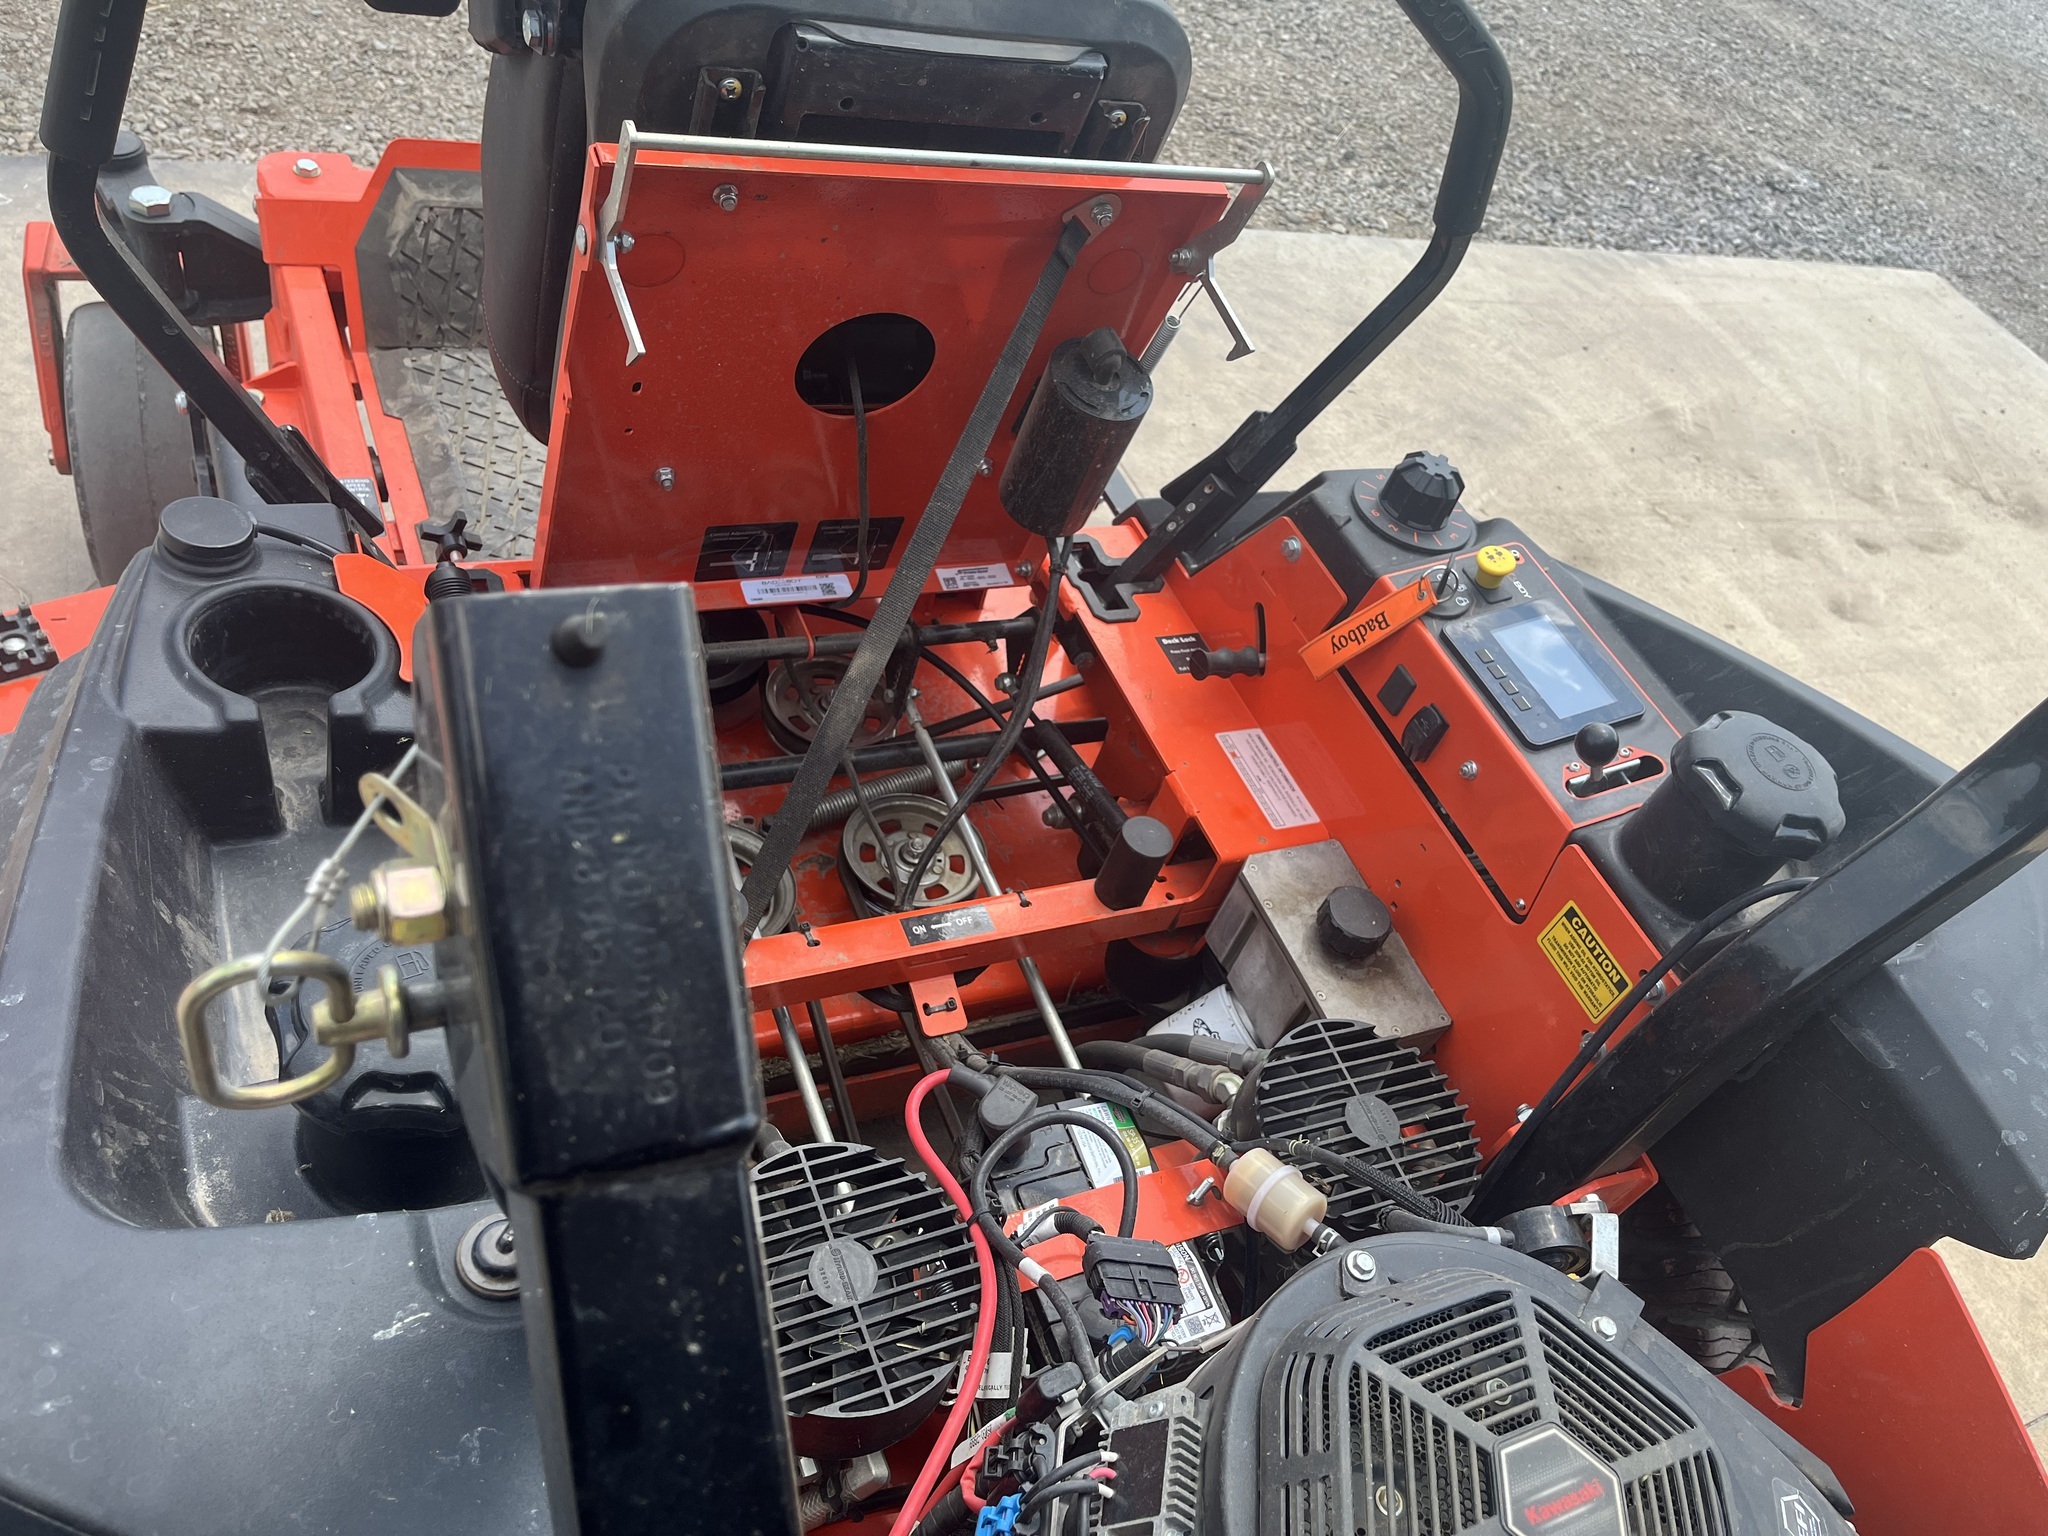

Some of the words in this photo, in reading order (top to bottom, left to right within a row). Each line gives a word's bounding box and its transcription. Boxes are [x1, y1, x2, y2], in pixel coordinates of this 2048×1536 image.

[1513, 581, 1532, 599] BOY
[1331, 610, 1391, 655] Badboy
[912, 925, 927, 934] ON
[956, 916, 973, 926] OFF
[1571, 917, 1620, 983] CAUTION
[1101, 1105, 1112, 1121] LAWN
[1524, 1478, 1605, 1525] Kawasaki
